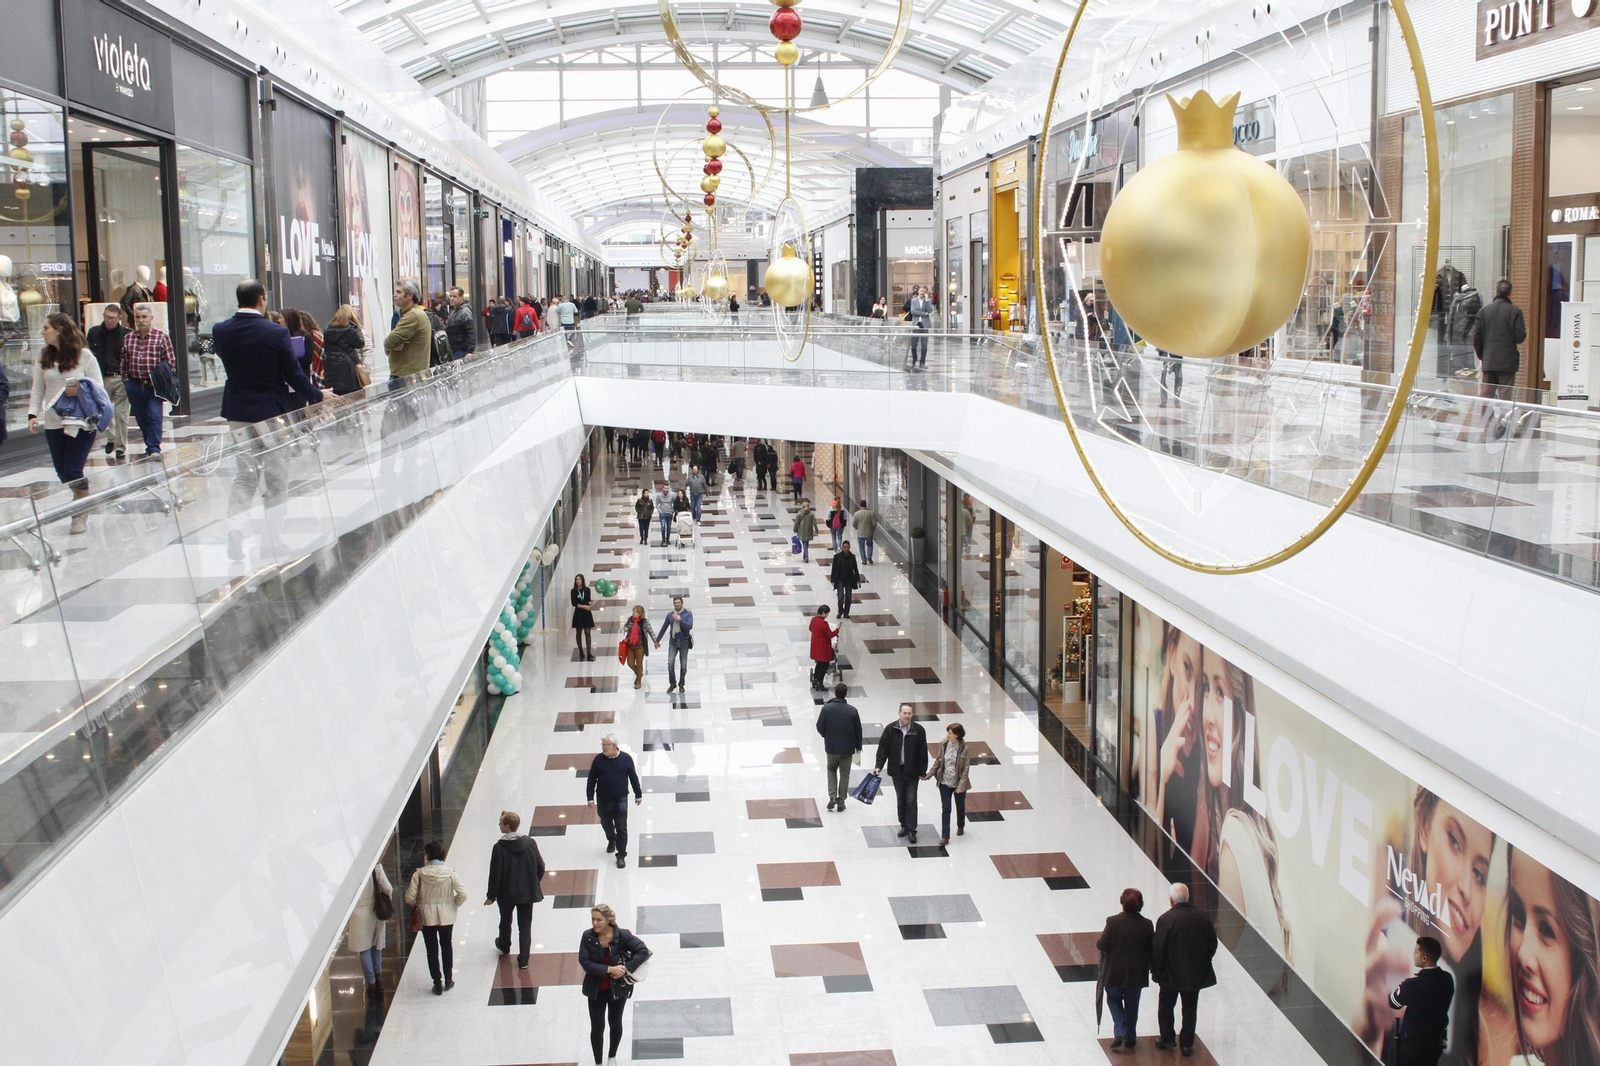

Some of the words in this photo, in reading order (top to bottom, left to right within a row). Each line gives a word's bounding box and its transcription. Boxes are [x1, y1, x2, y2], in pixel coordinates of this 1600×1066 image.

[93, 32, 151, 92] violeta
[1564, 205, 1600, 224] ROMA
[280, 215, 321, 276] LOVE
[346, 228, 351, 278] I
[351, 229, 379, 279] LOVE
[398, 236, 420, 277] LOVE
[1573, 313, 1581, 339] ROMA
[1572, 350, 1580, 372] PUNT
[1221, 694, 1233, 789] I
[1243, 710, 1373, 909] LOVE
[1403, 896, 1431, 926] SHOPPING
